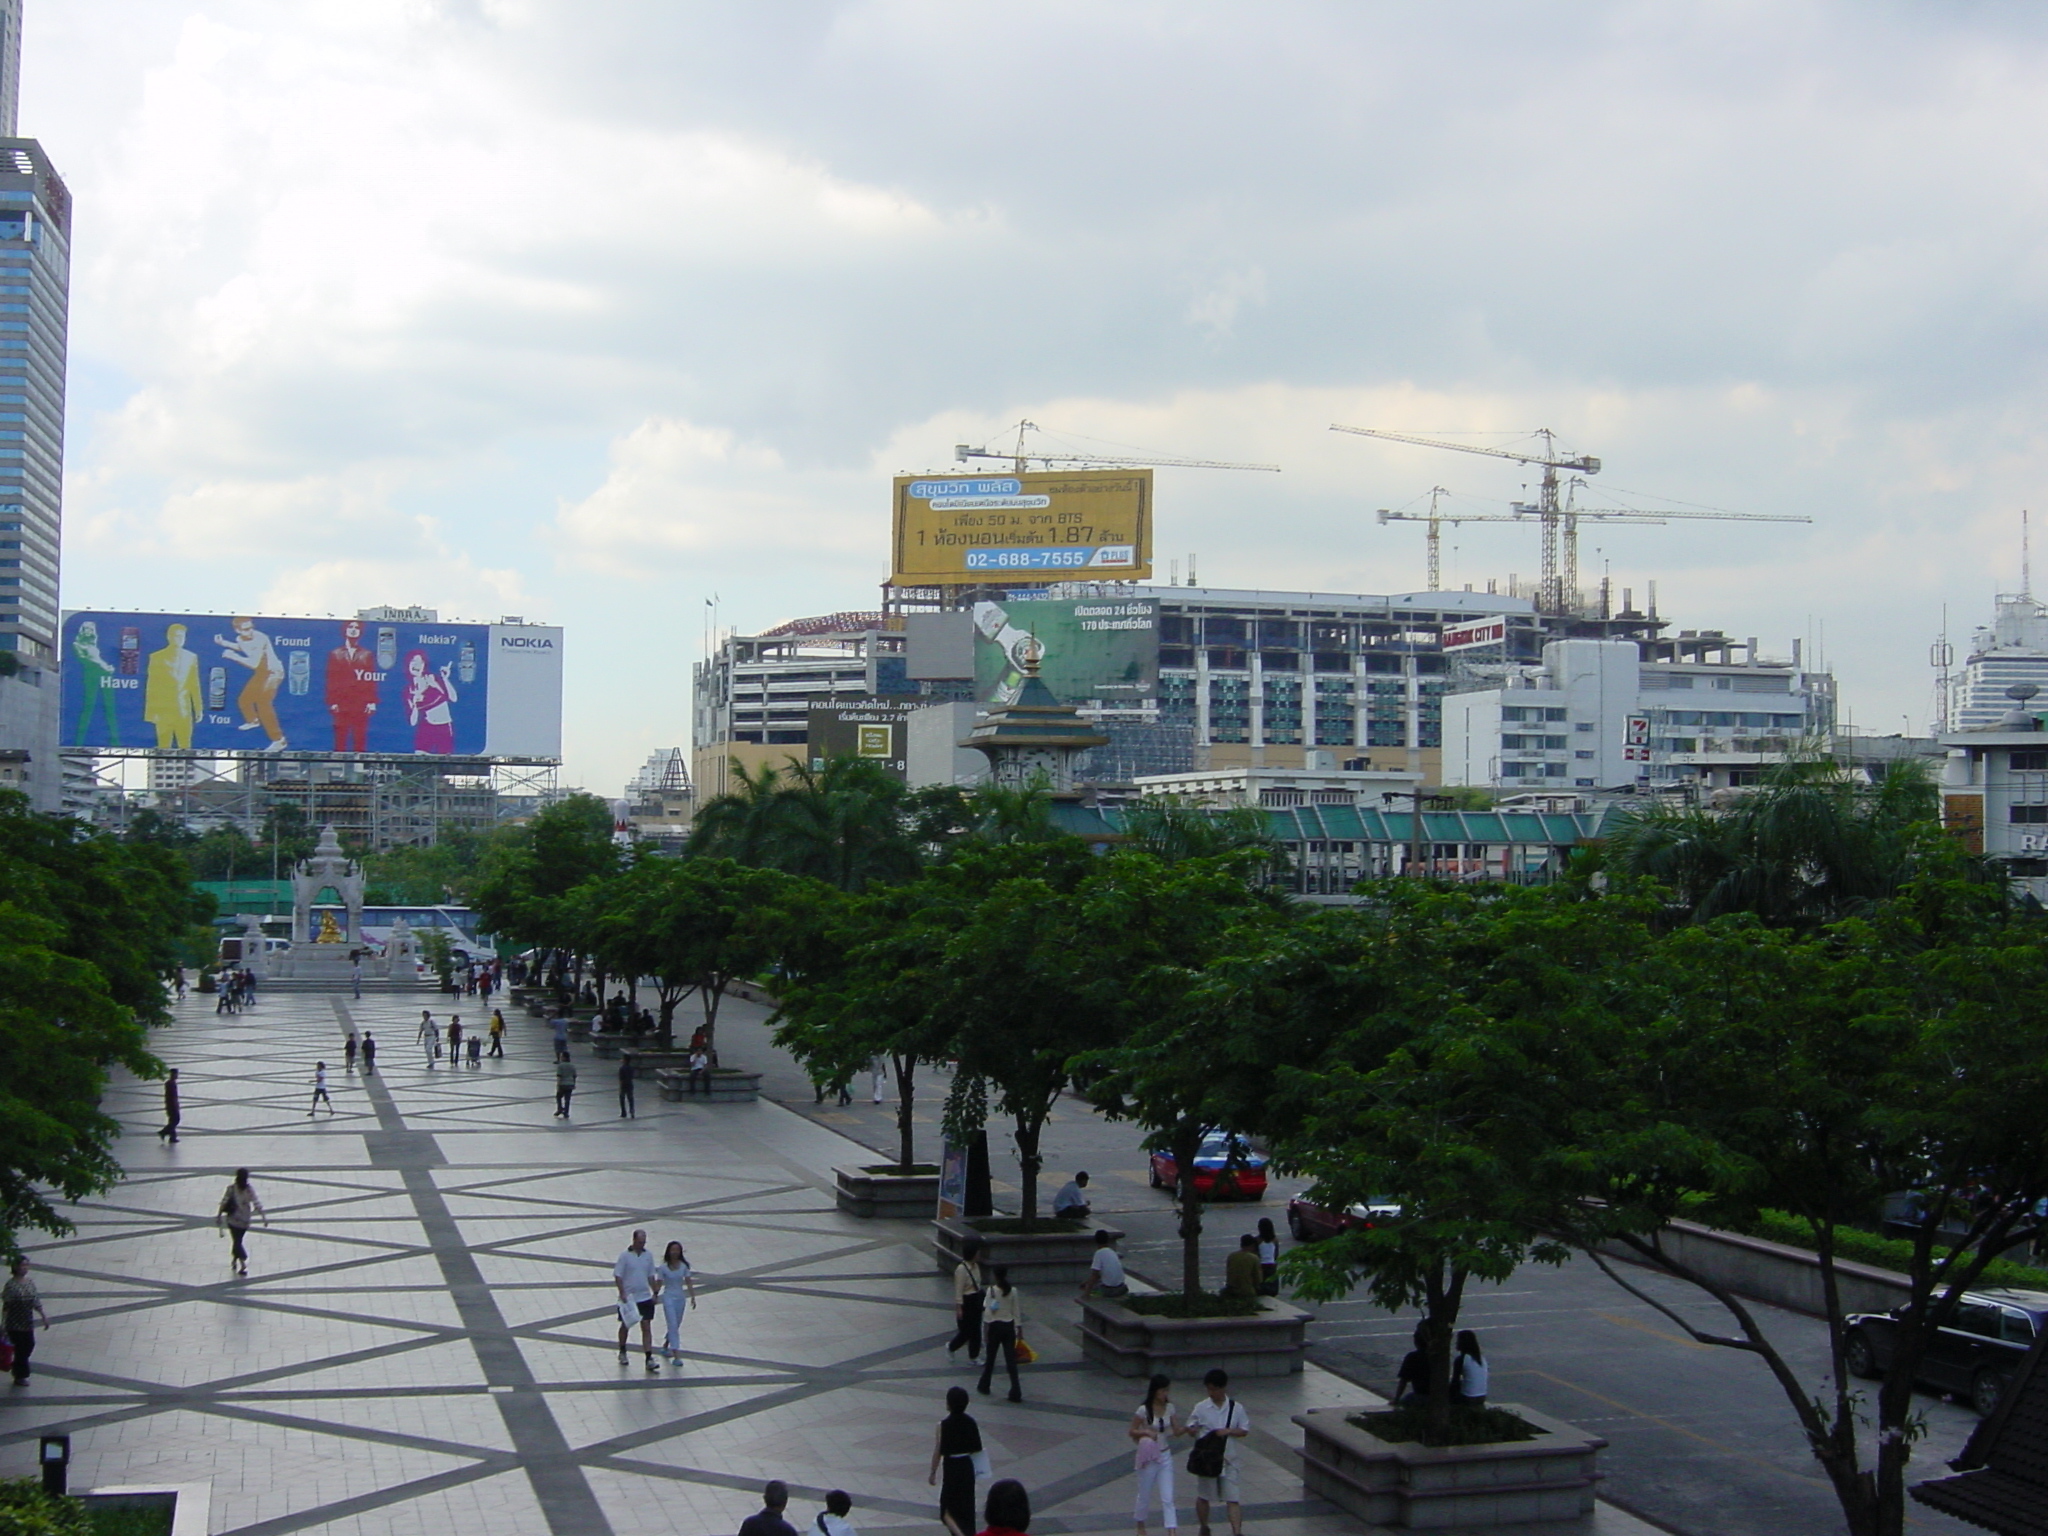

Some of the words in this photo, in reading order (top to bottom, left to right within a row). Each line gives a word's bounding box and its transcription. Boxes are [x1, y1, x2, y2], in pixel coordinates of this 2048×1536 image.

[954, 513, 983, 527] เพียง
[988, 515, 1006, 526] 50
[1029, 514, 1052, 525] จาก
[1058, 513, 1083, 524] BTS
[1048, 526, 1095, 543] 1.87
[1099, 529, 1124, 542] ล้าน
[966, 551, 1084, 566] 02-688-7555
[383, 609, 422, 620] INDRA
[1114, 606, 1125, 616] 24
[274, 635, 311, 648] Found
[418, 634, 457, 645] Nokia?
[501, 637, 554, 649] NOKIA
[99, 674, 139, 690] Have
[354, 668, 388, 684] Your
[208, 713, 231, 725] You
